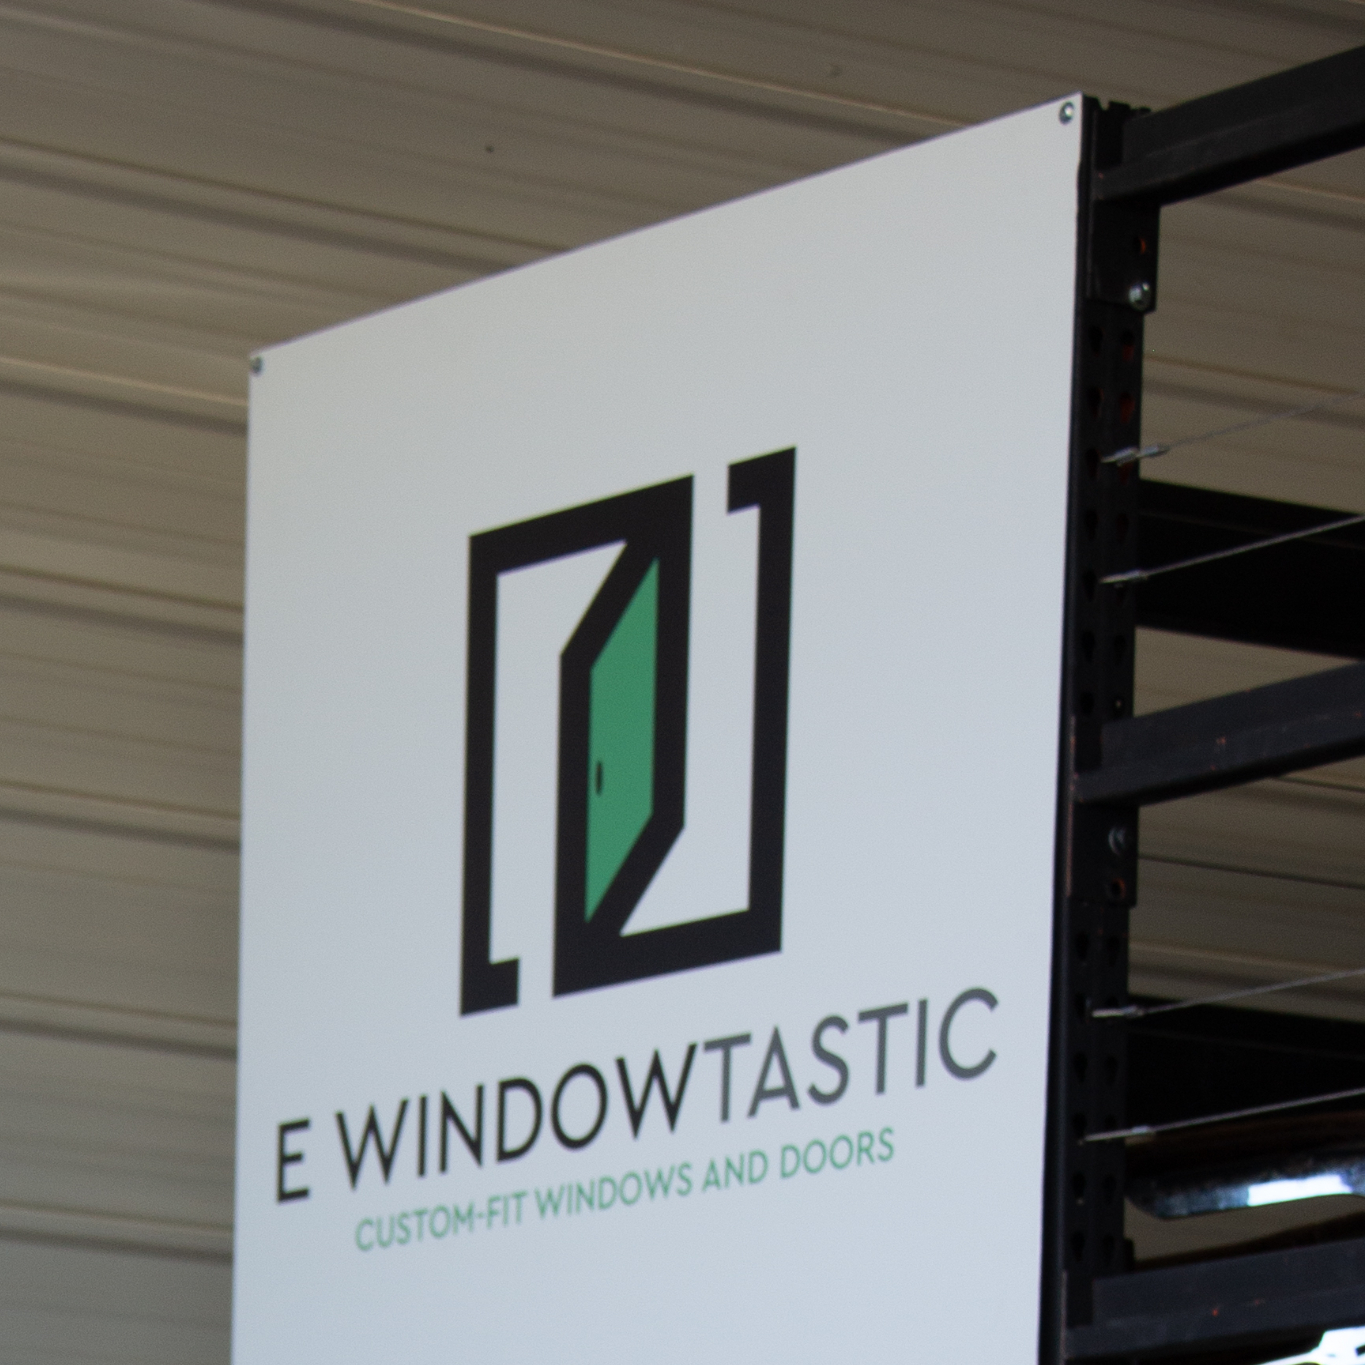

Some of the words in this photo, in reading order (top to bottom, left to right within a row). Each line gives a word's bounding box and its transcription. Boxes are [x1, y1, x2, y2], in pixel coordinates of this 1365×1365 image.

[275, 1117, 312, 1206] E
[334, 986, 1000, 1191] WINDOWTASTIC
[354, 1190, 528, 1252] CUSTOM-FIT
[534, 1162, 694, 1218] WINDOWS
[701, 1149, 770, 1193] AND
[778, 1127, 896, 1180] DOORS
